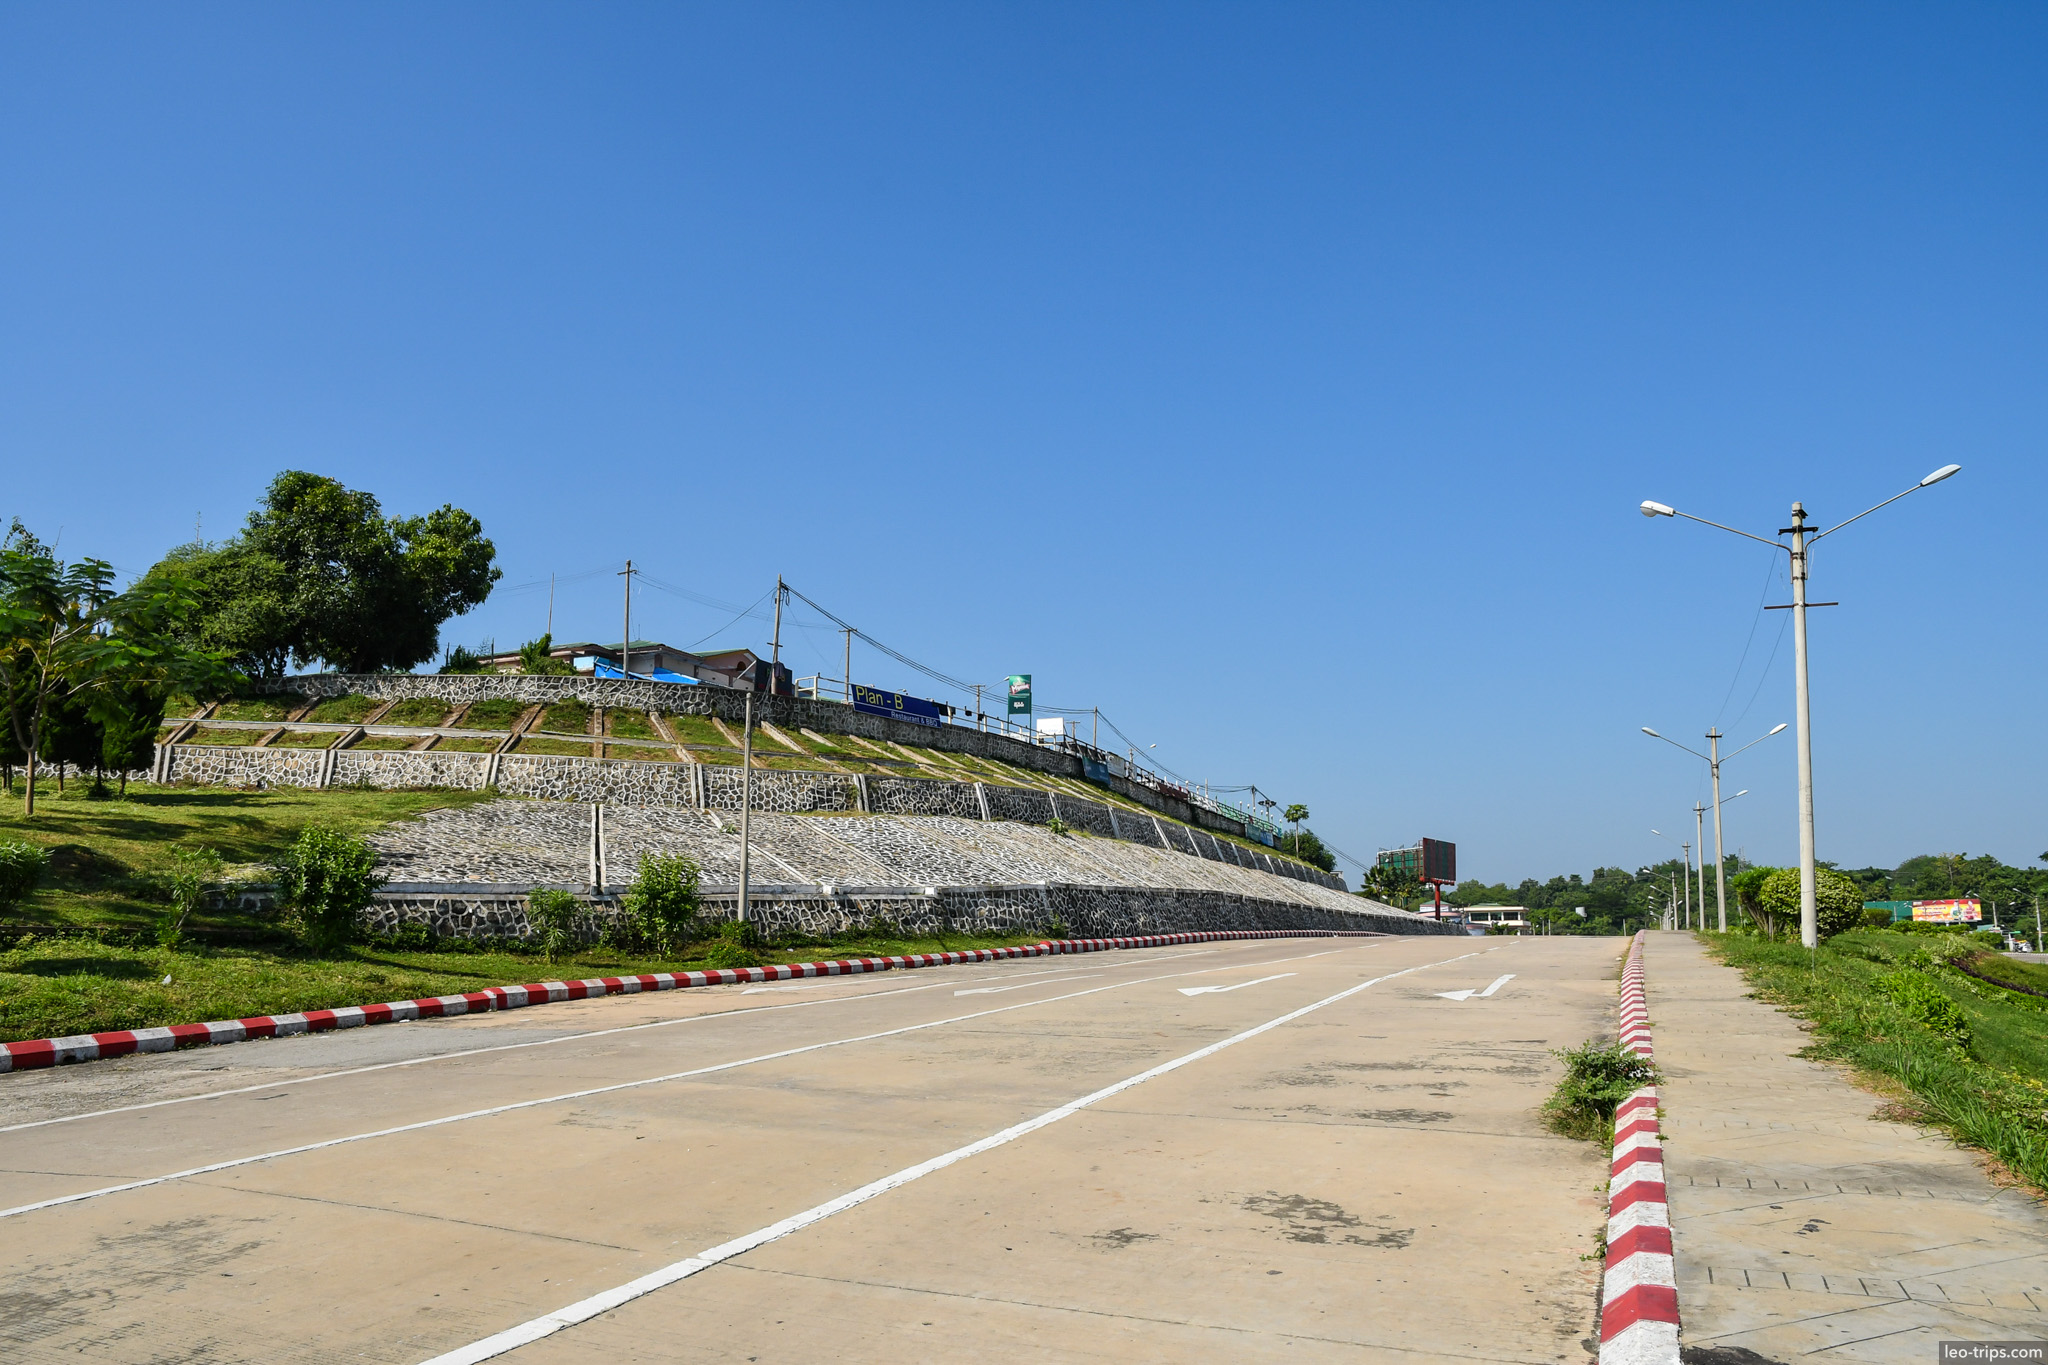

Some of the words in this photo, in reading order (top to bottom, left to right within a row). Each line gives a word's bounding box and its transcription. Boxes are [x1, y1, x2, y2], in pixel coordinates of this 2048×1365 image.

[856, 686, 883, 706] Plan
[894, 694, 903, 709] B
[891, 711, 919, 723] Restaurant
